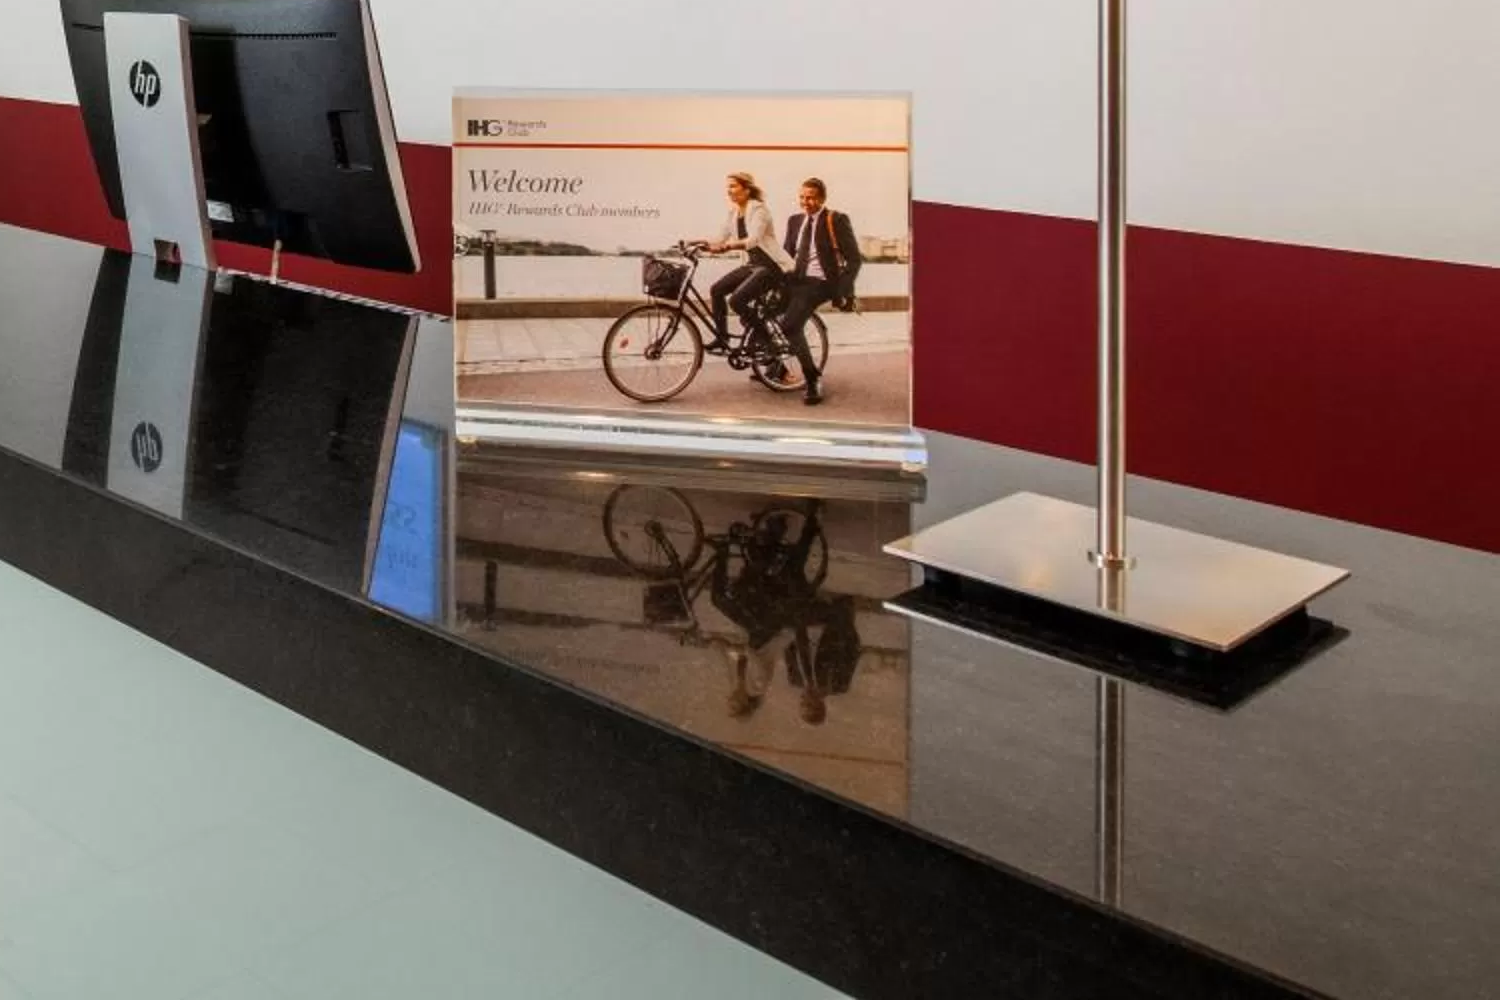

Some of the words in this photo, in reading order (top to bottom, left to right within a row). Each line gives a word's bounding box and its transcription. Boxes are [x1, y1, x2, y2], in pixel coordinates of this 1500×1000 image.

[131, 60, 160, 107] hp
[467, 119, 502, 137] IHG
[507, 119, 547, 129] Rewards
[468, 168, 584, 195] Welcome
[506, 202, 564, 217] Rewards
[566, 203, 598, 217] Club
[599, 204, 661, 219] members
